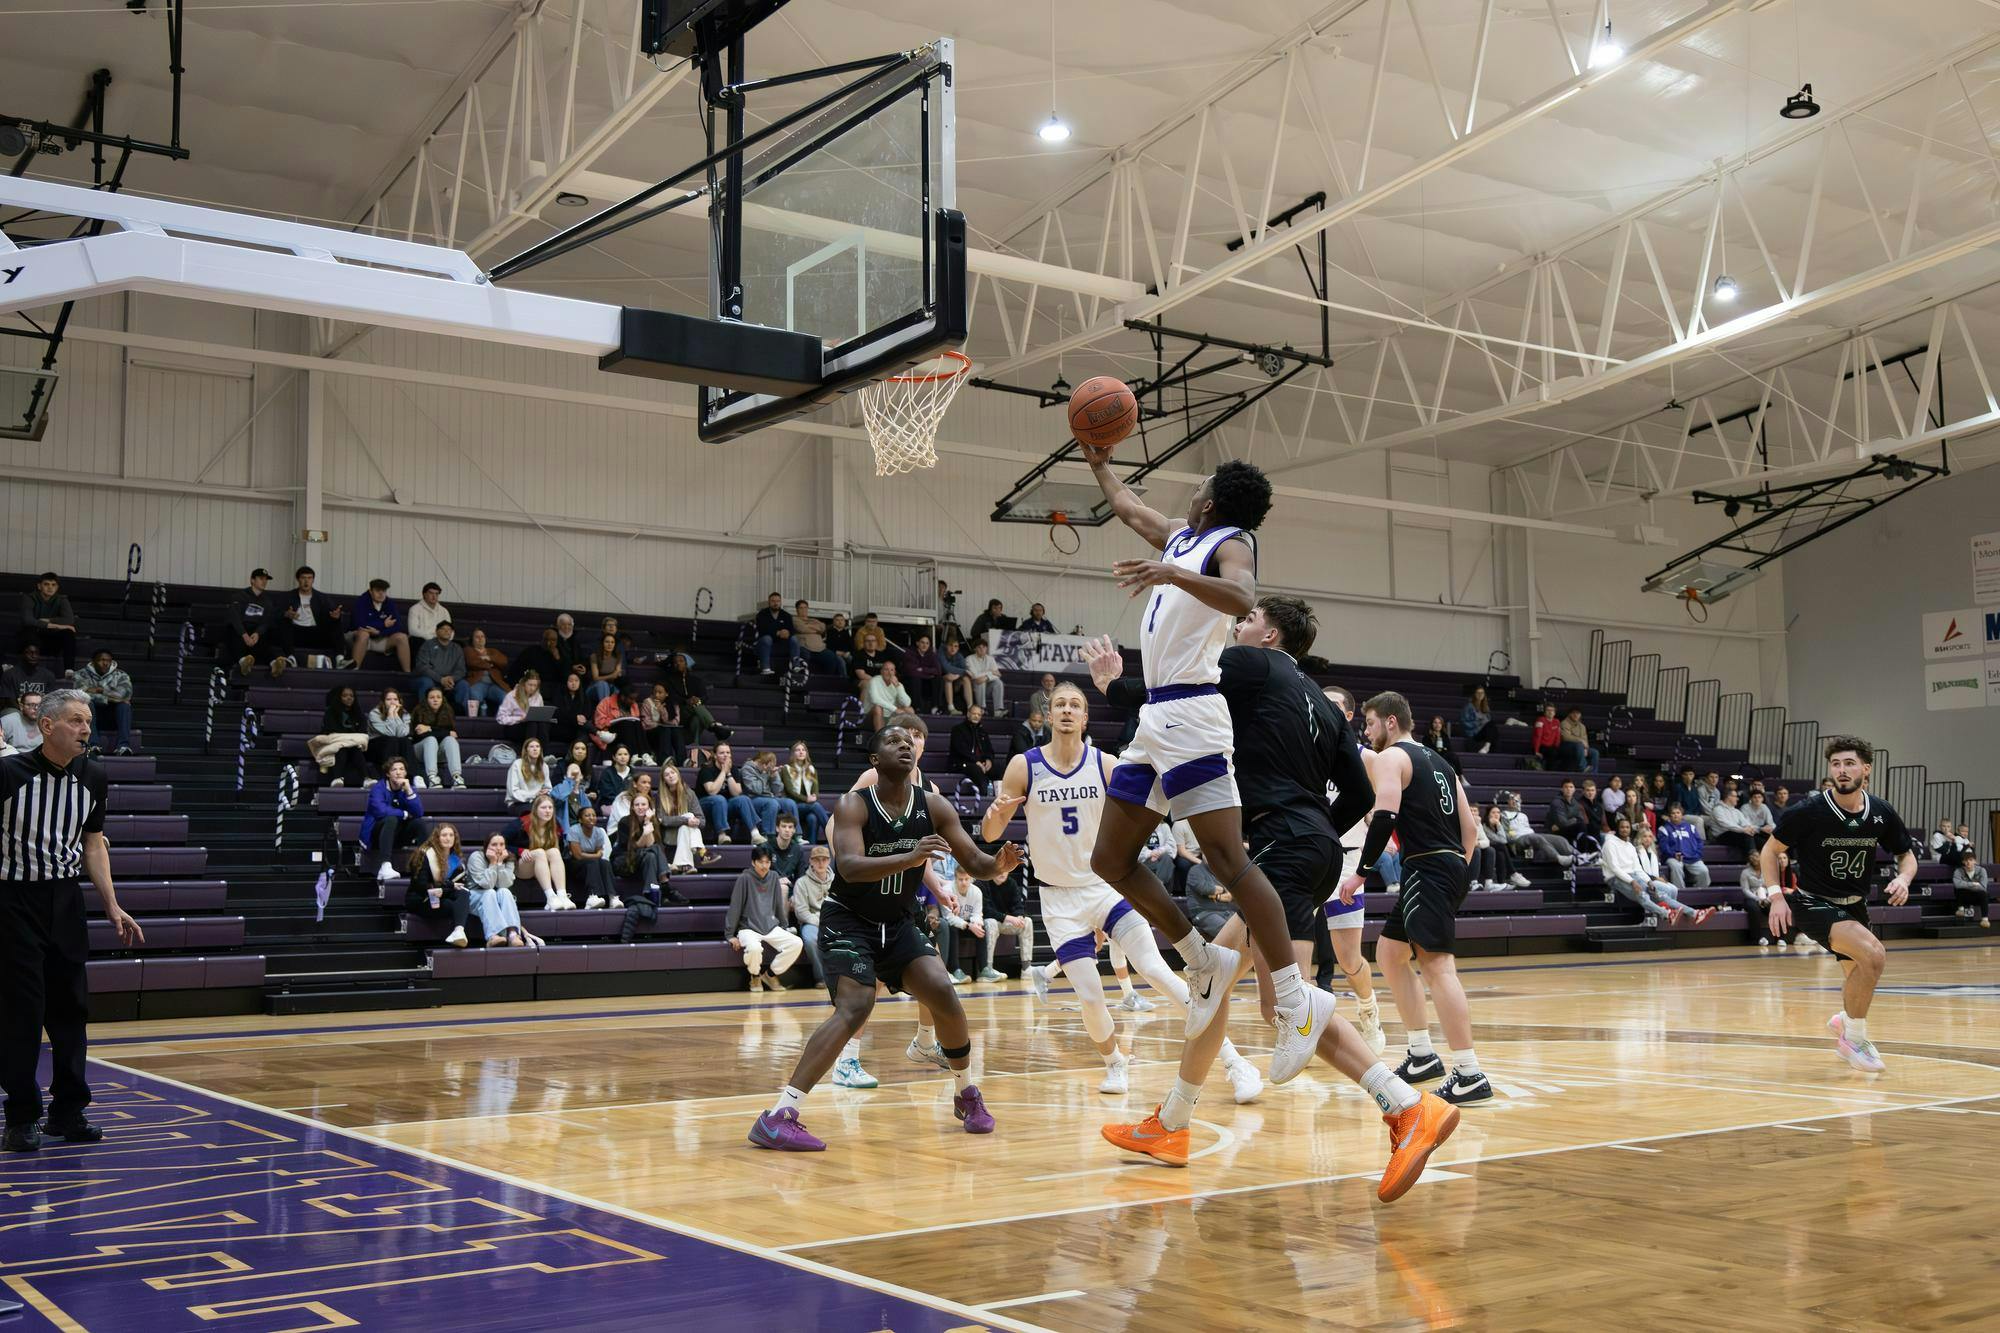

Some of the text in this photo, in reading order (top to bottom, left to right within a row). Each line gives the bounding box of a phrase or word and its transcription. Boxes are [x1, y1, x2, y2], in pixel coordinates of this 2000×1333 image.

[1040, 643, 1088, 663] TAYL
[1038, 786, 1099, 803] TAYLOR
[1433, 770, 1454, 816] 3
[1060, 806, 1079, 835] 5
[1830, 850, 1866, 879] 24
